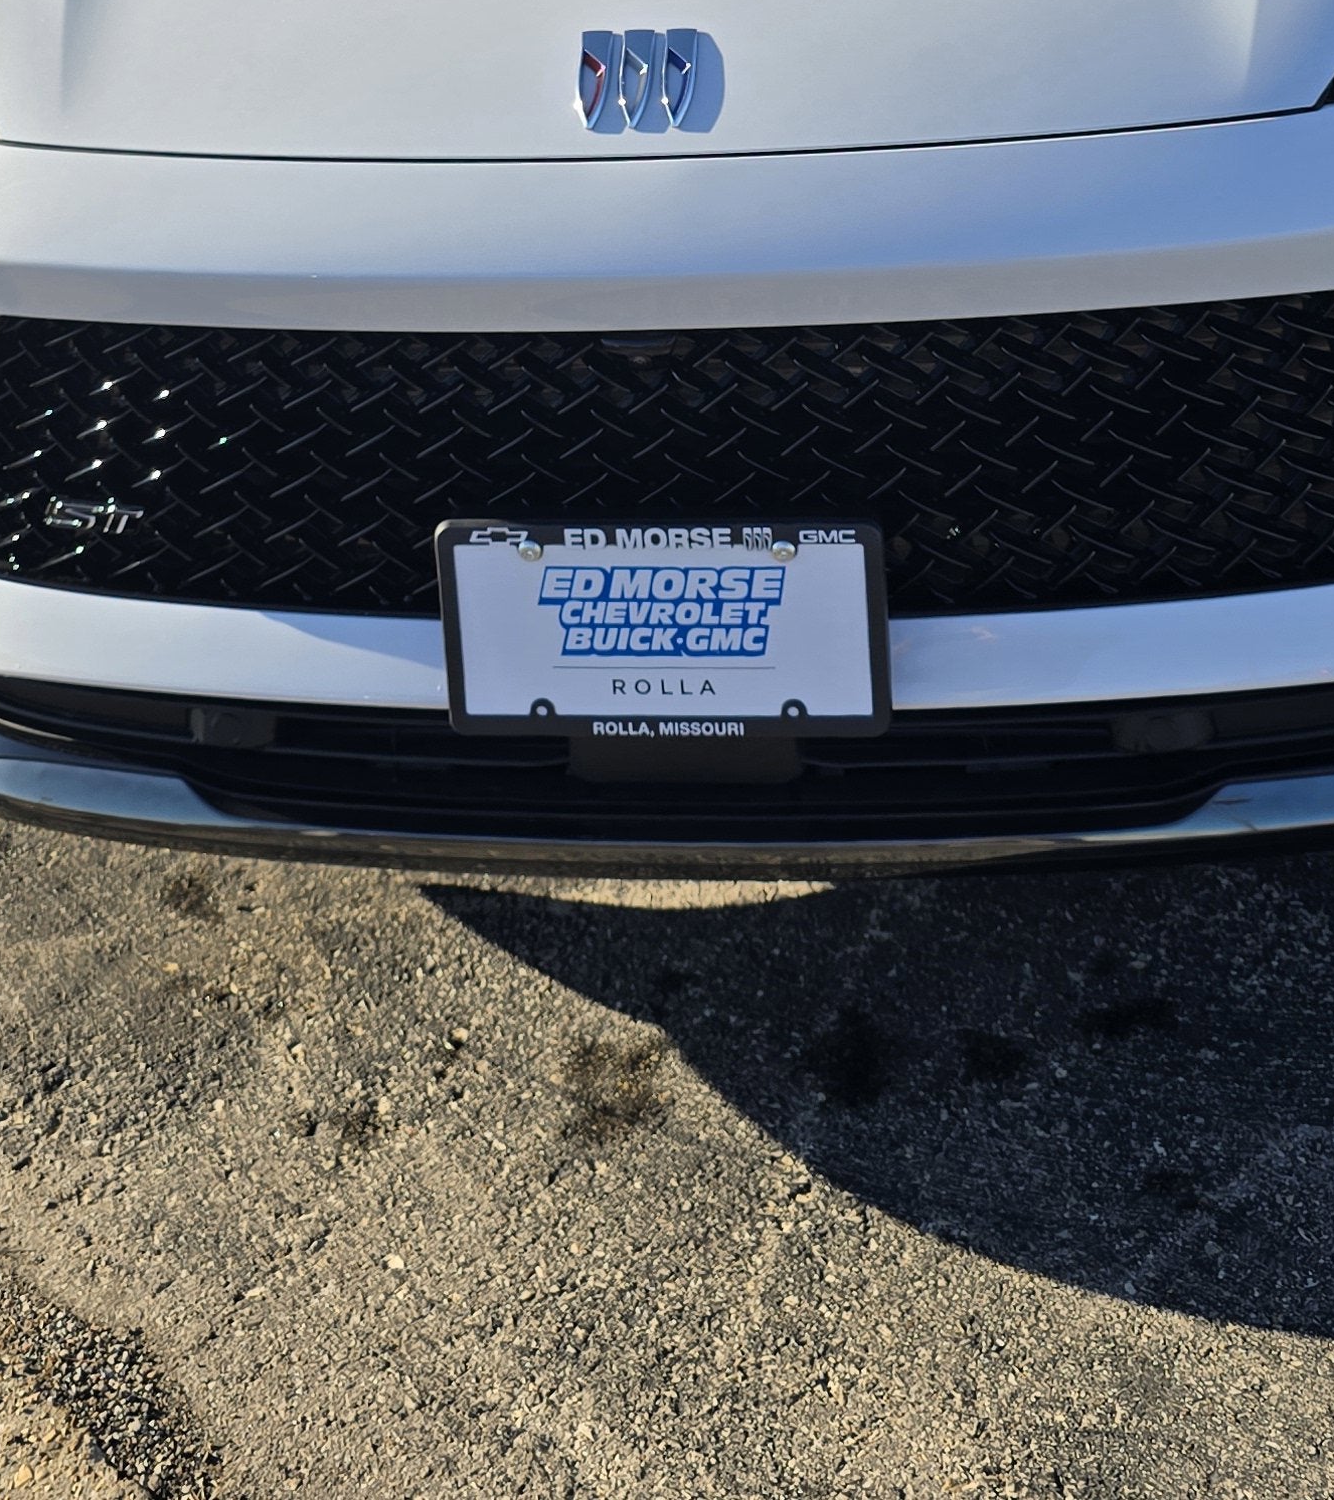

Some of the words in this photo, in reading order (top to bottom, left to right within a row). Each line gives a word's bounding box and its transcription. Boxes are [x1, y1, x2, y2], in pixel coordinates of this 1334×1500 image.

[563, 528, 607, 550] ED
[615, 527, 731, 550] MORSE
[799, 529, 856, 543] GMC
[541, 568, 606, 599] ED
[608, 568, 784, 601] MORSE
[561, 600, 766, 625] CHEVROLET
[611, 678, 716, 696] ROLLA
[592, 721, 655, 738] ROLLA,
[658, 721, 745, 737] MISSOURI
